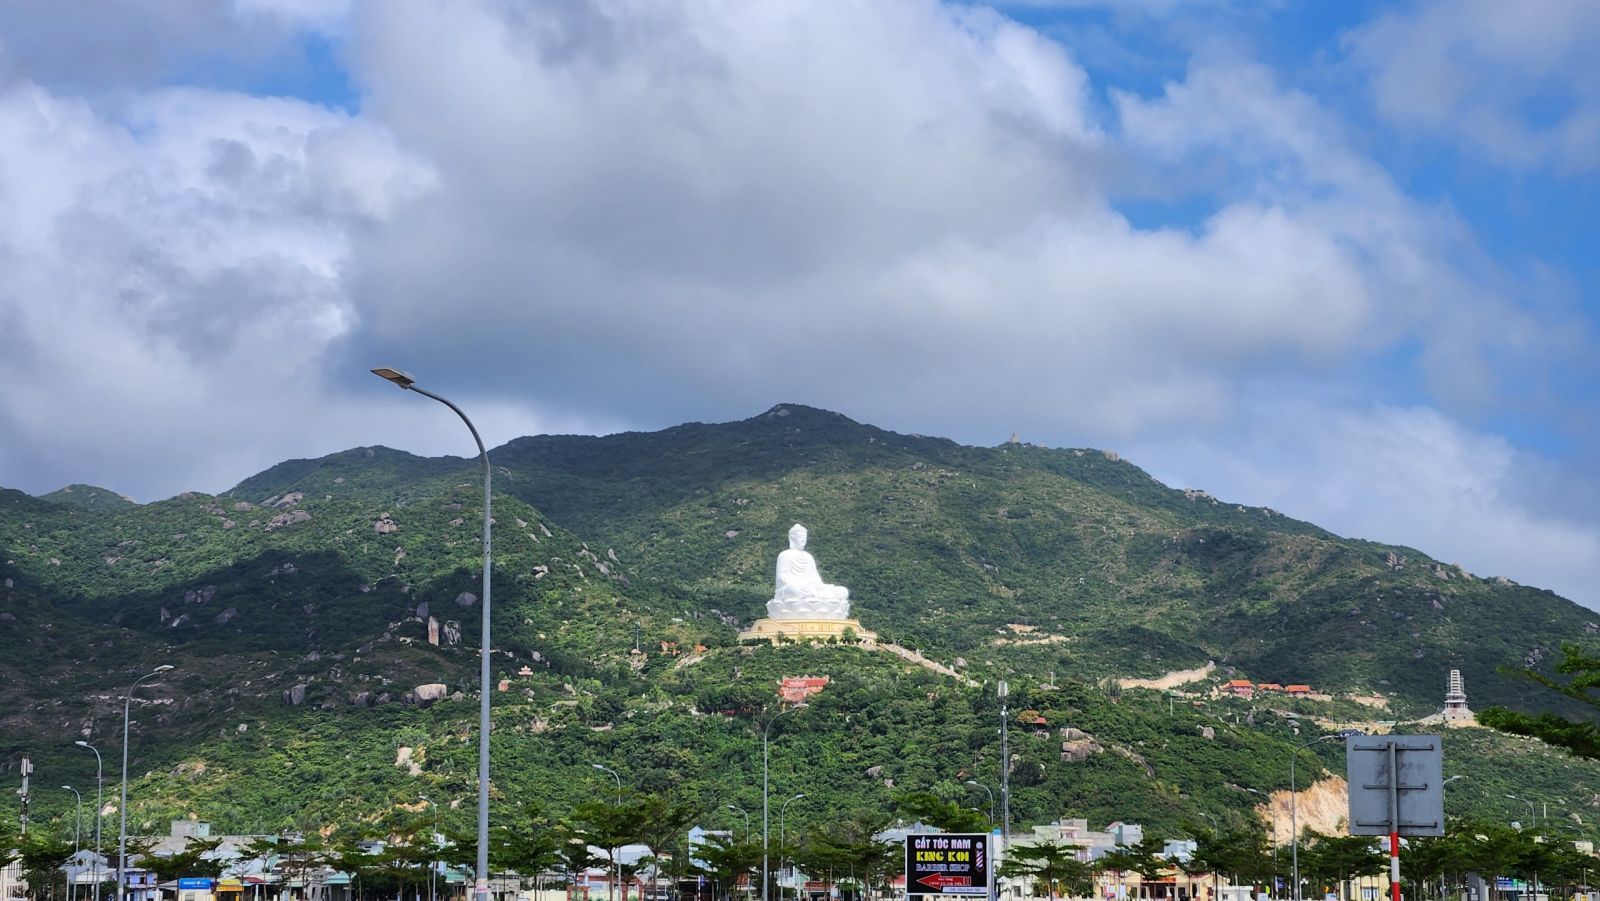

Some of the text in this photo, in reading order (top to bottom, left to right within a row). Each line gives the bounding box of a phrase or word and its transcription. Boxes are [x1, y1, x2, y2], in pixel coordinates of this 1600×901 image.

[933, 837, 949, 849] TÓC
[951, 839, 971, 849] NAM
[916, 851, 970, 862] KING KOI
[915, 864, 970, 872] BARBER SHOP
